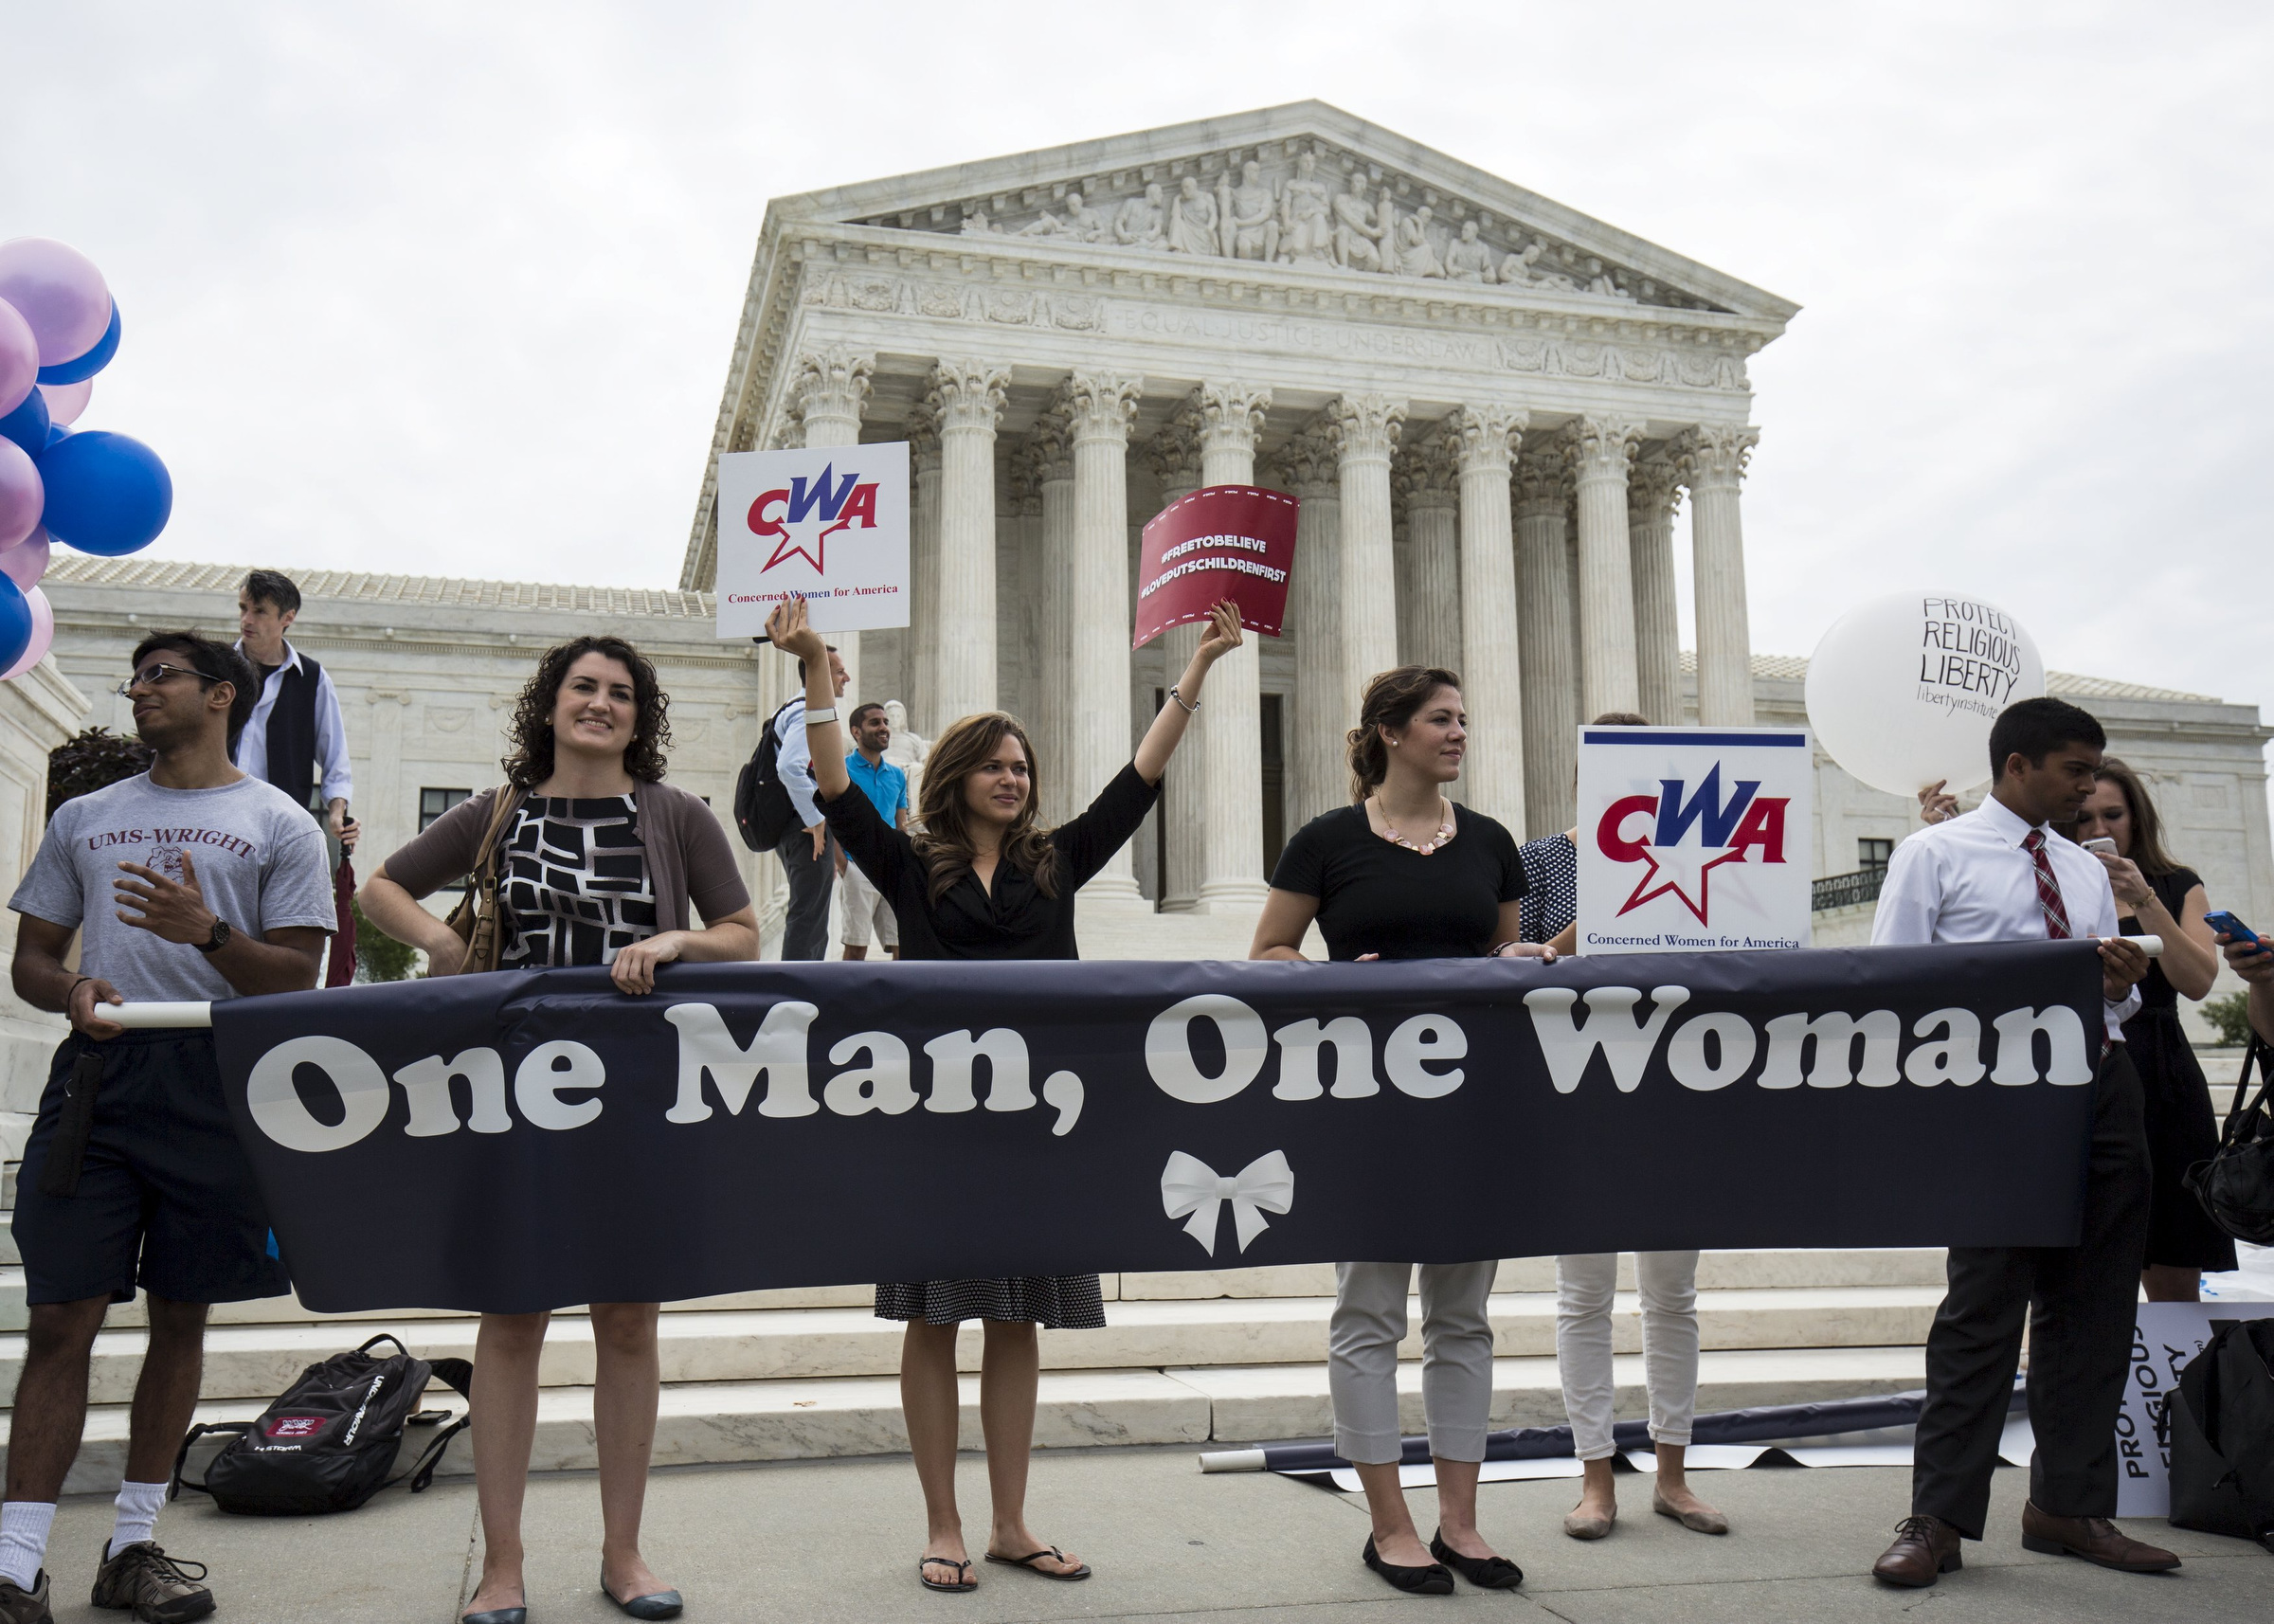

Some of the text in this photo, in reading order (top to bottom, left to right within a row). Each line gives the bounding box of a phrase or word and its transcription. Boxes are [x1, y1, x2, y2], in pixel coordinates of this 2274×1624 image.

[1125, 309, 1478, 360] EQUAL JUSTICE UNDER LAW
[748, 461, 880, 536] CWA
[1161, 535, 1266, 564] #FREETOBELIEVE
[728, 591, 787, 604] Concerned
[834, 587, 850, 597] for
[853, 585, 898, 596] America
[1141, 557, 1286, 599] #LOVEPUTSCHILDRENFIRST
[1923, 598, 2016, 640] PROTECT
[1923, 621, 2020, 675] RELIGIOUS
[1921, 654, 2018, 704] LIBERTY
[1597, 759, 1791, 863] CWA
[88, 828, 256, 859] UMS-WRIGHT
[1587, 932, 1799, 948] Concerned Women for America
[247, 984, 2093, 1152] One Man, One Woman
